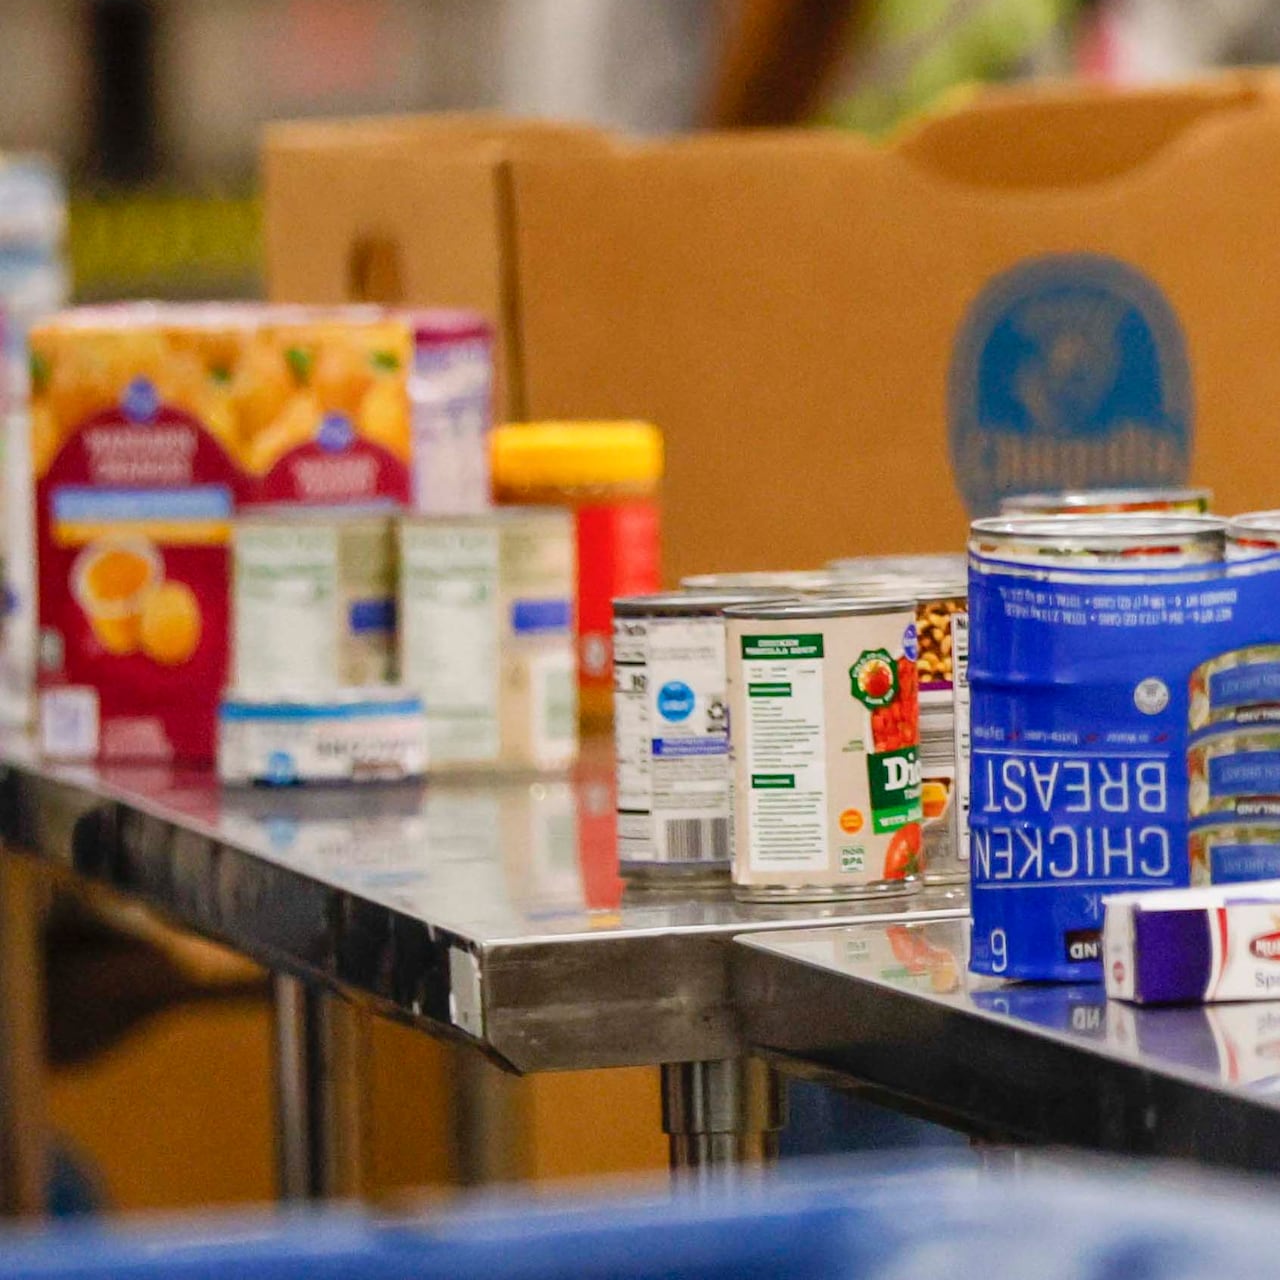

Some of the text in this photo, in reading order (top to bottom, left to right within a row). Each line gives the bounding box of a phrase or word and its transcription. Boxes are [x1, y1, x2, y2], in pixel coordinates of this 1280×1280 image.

[982, 758, 1168, 813] BREAST
[972, 823, 1171, 879] CHICKEN
[988, 929, 1008, 972] 6
